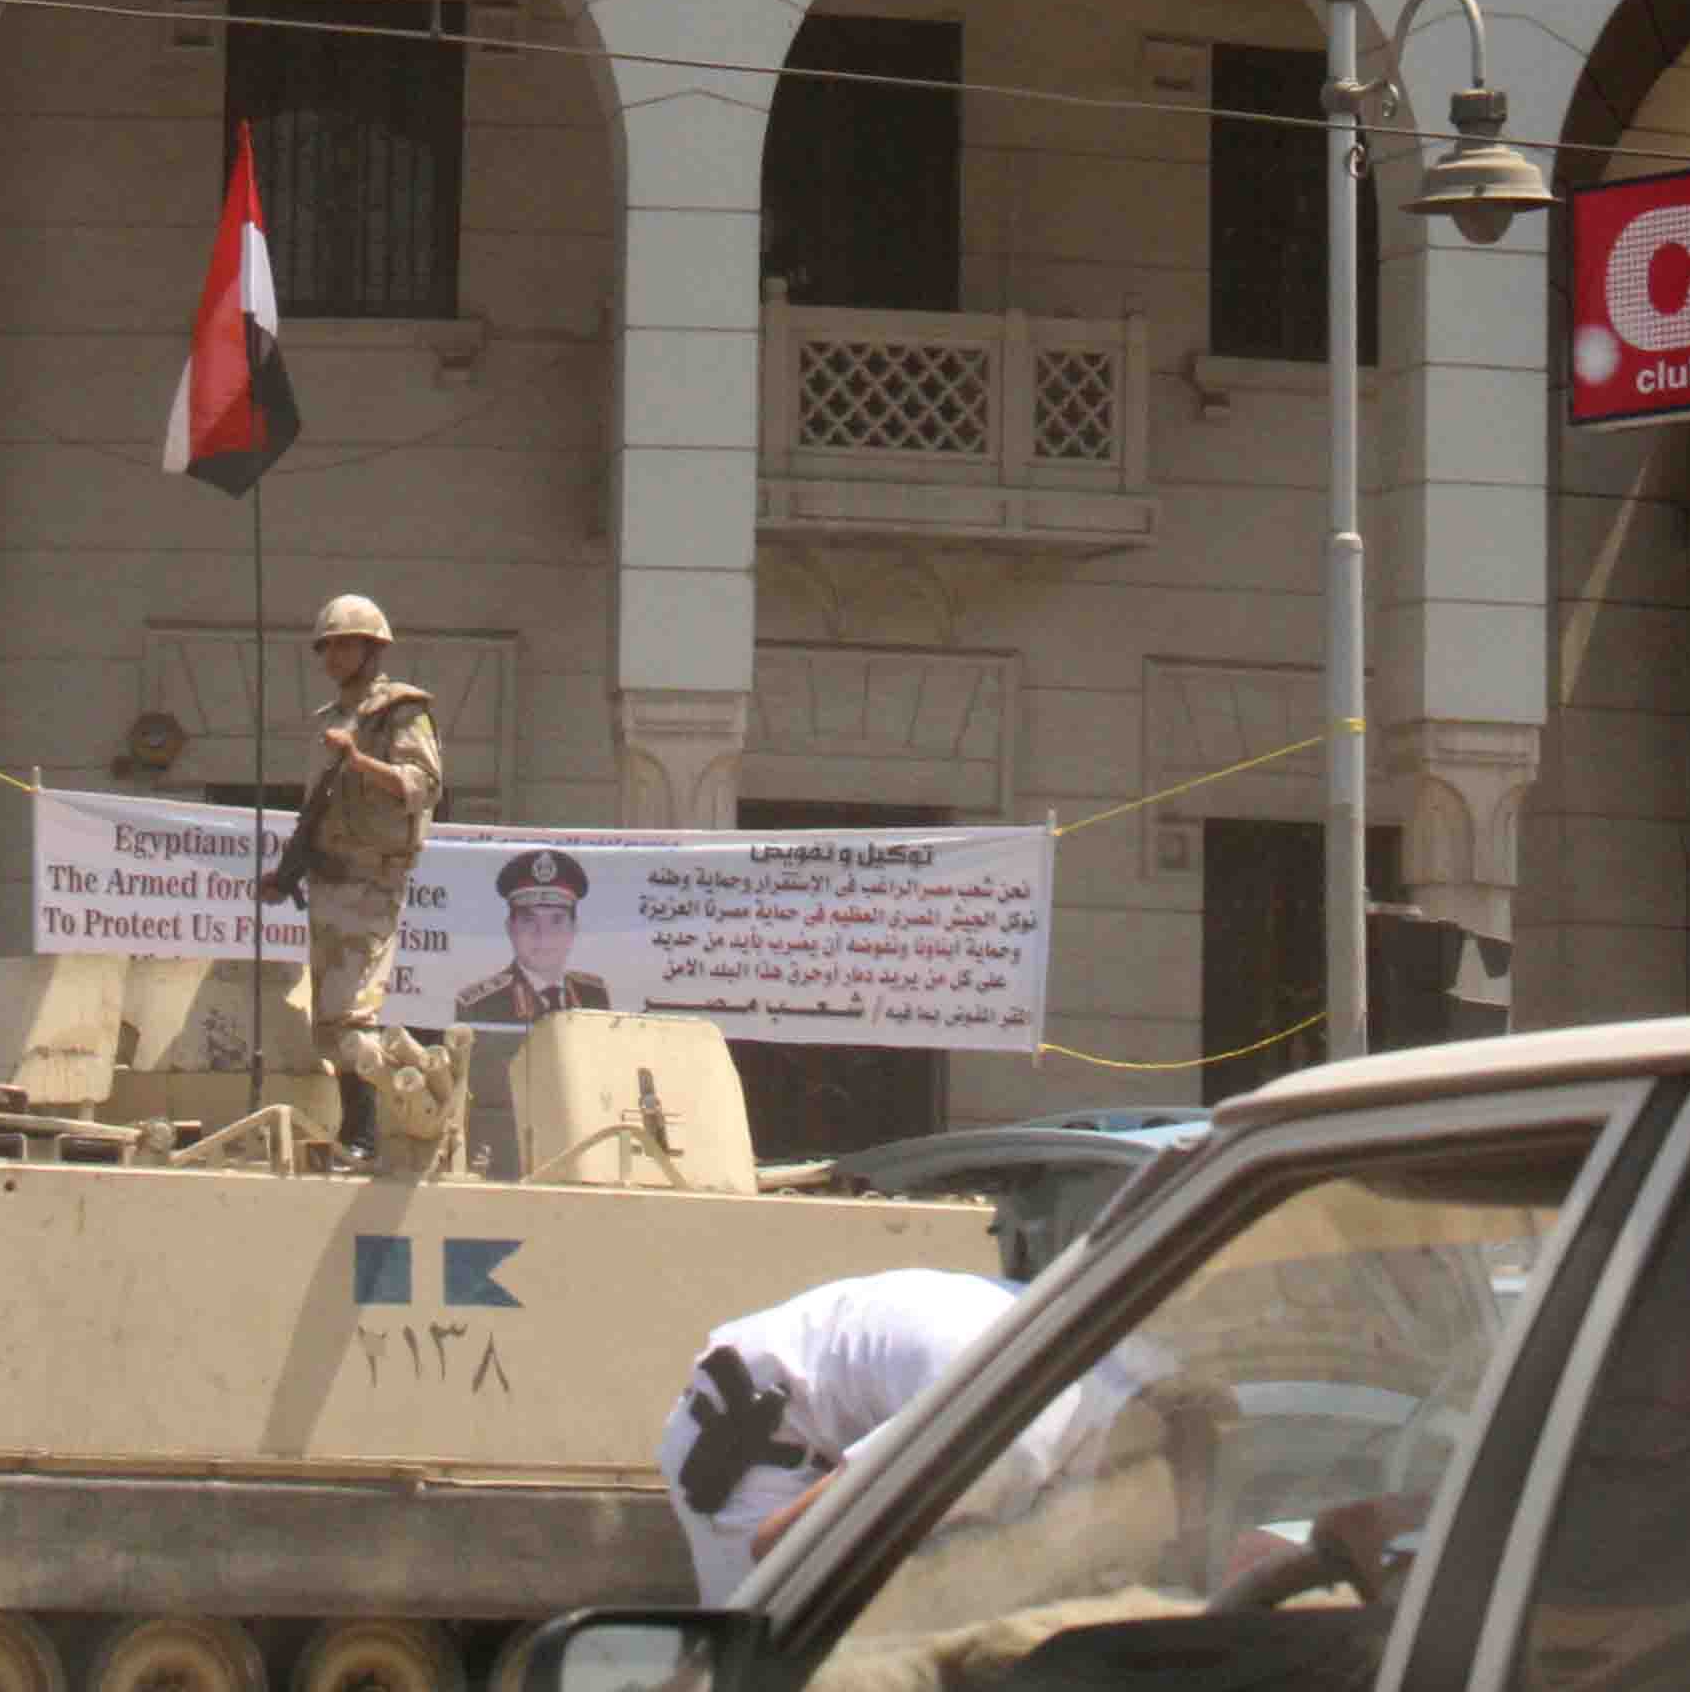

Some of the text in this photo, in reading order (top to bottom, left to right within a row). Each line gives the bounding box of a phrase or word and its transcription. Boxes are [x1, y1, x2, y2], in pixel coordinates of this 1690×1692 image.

[114, 824, 251, 859] Egyptians
[48, 865, 98, 893] The
[106, 868, 197, 899] Armed
[207, 874, 258, 900] forc
[44, 907, 75, 936] To
[84, 909, 182, 940] Protect
[193, 914, 226, 943] Us
